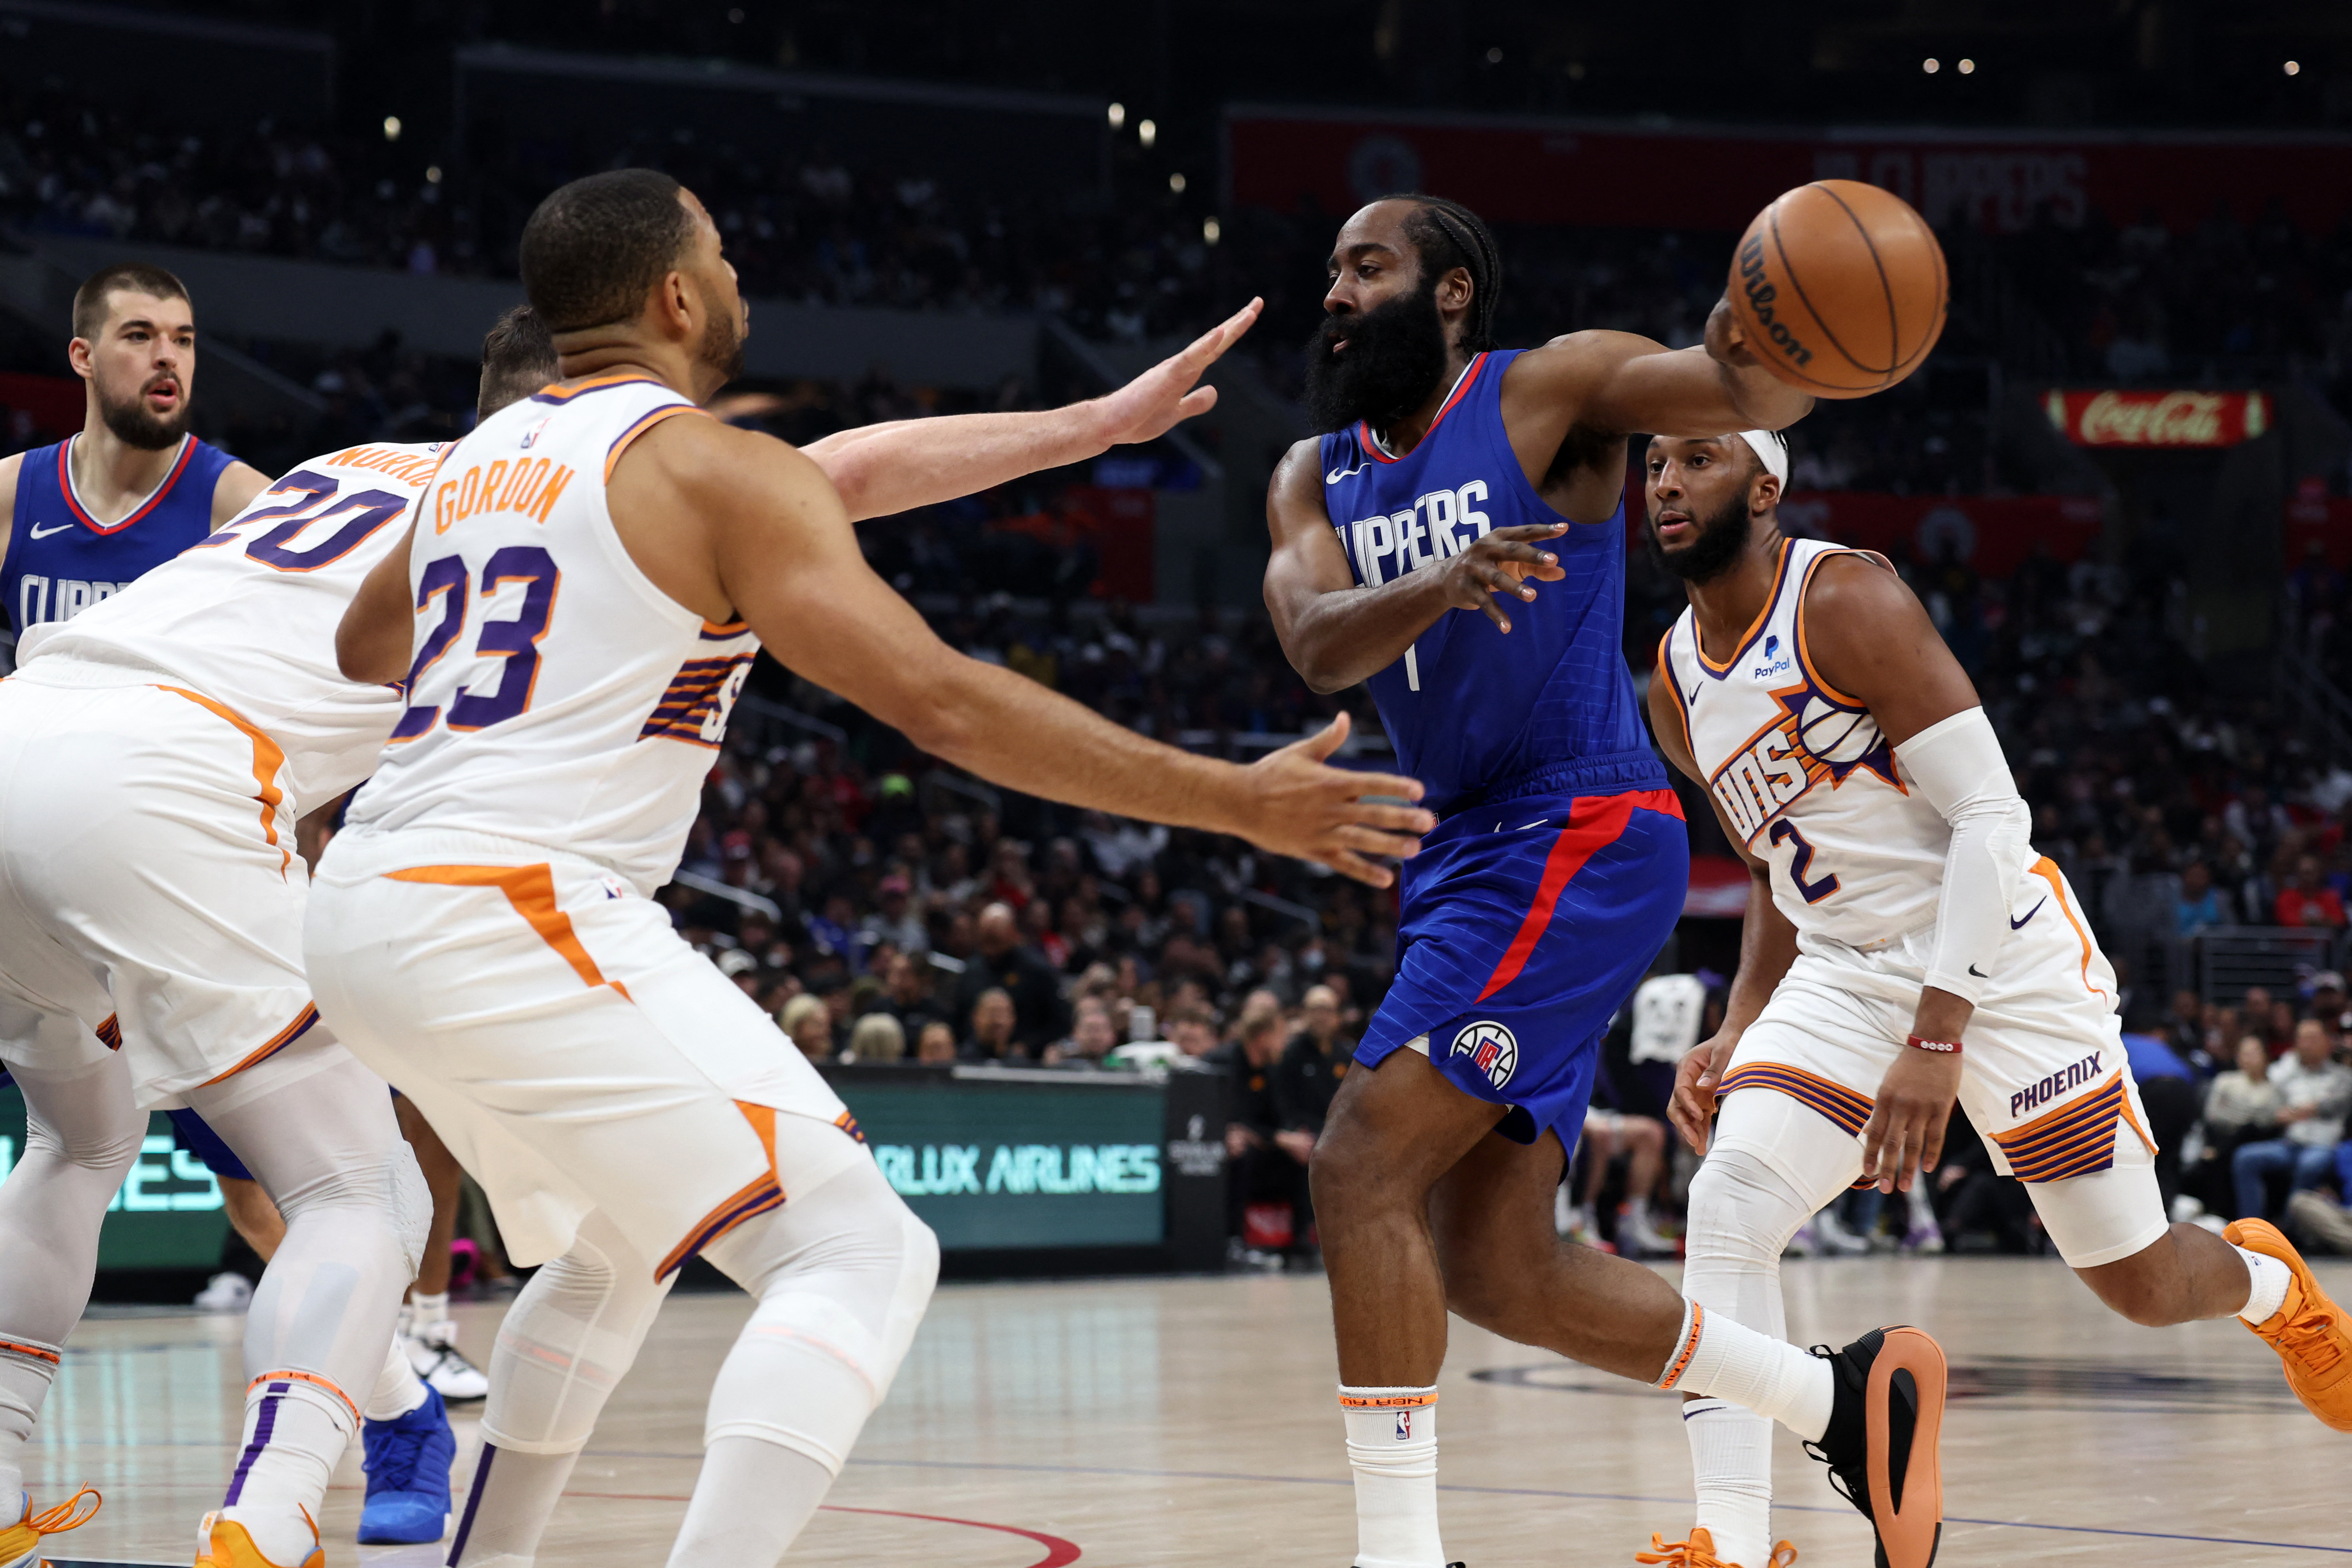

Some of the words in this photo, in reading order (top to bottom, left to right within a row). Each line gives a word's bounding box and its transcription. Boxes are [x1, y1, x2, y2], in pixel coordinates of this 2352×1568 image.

[1740, 230, 1813, 366] Wilson
[178, 470, 409, 572] 20
[435, 457, 575, 536] GORDON
[385, 546, 561, 745] 23
[1755, 657, 1789, 679] PayPal
[1769, 818, 1840, 905] 2
[2010, 1050, 2103, 1119] PHOENIX
[985, 1144, 1162, 1195] AIRLINES
